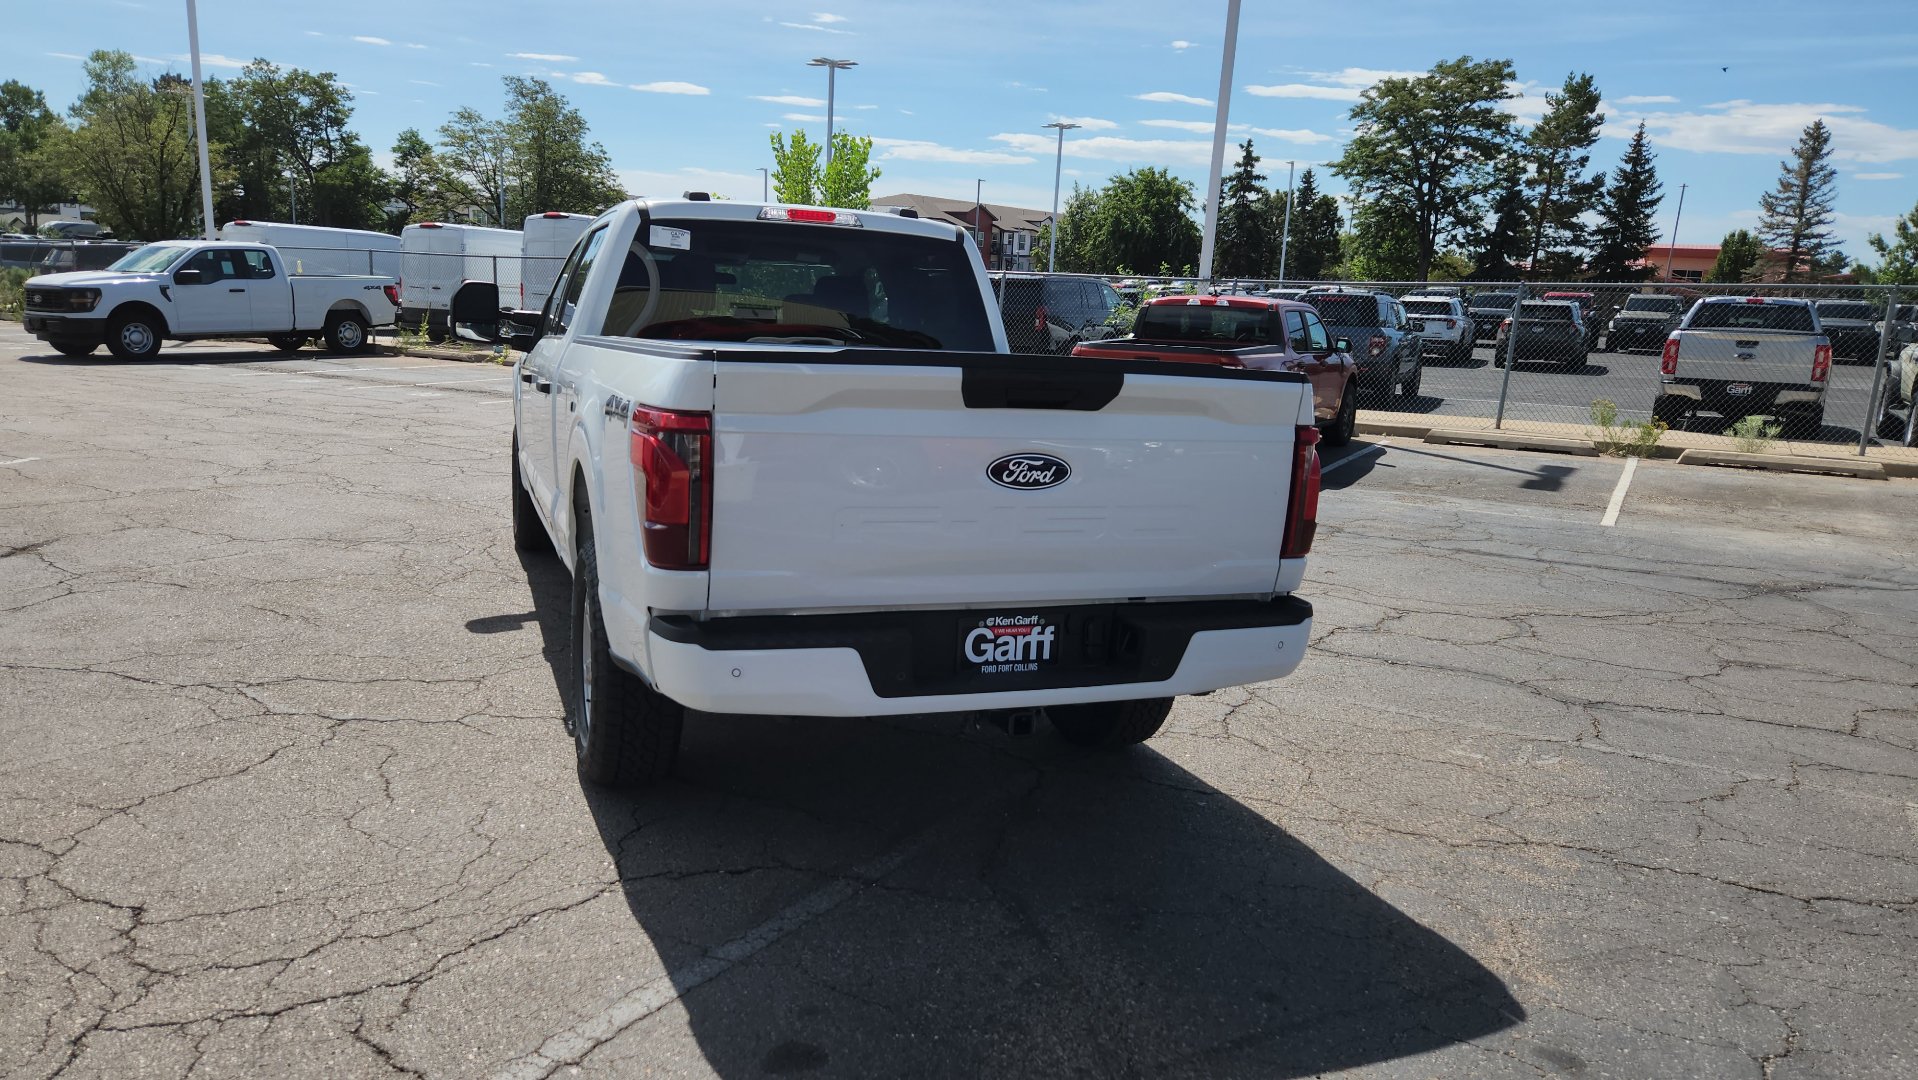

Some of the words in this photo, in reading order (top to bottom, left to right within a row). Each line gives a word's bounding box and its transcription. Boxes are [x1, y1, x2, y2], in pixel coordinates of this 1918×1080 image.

[1002, 459, 1057, 483] Ford
[995, 616, 1014, 626] Ken
[1015, 615, 1039, 625] Garff
[965, 626, 1055, 663] Garff
[981, 665, 997, 673] FORD
[998, 664, 1013, 673] FORT
[1013, 663, 1038, 672] COLLINS
